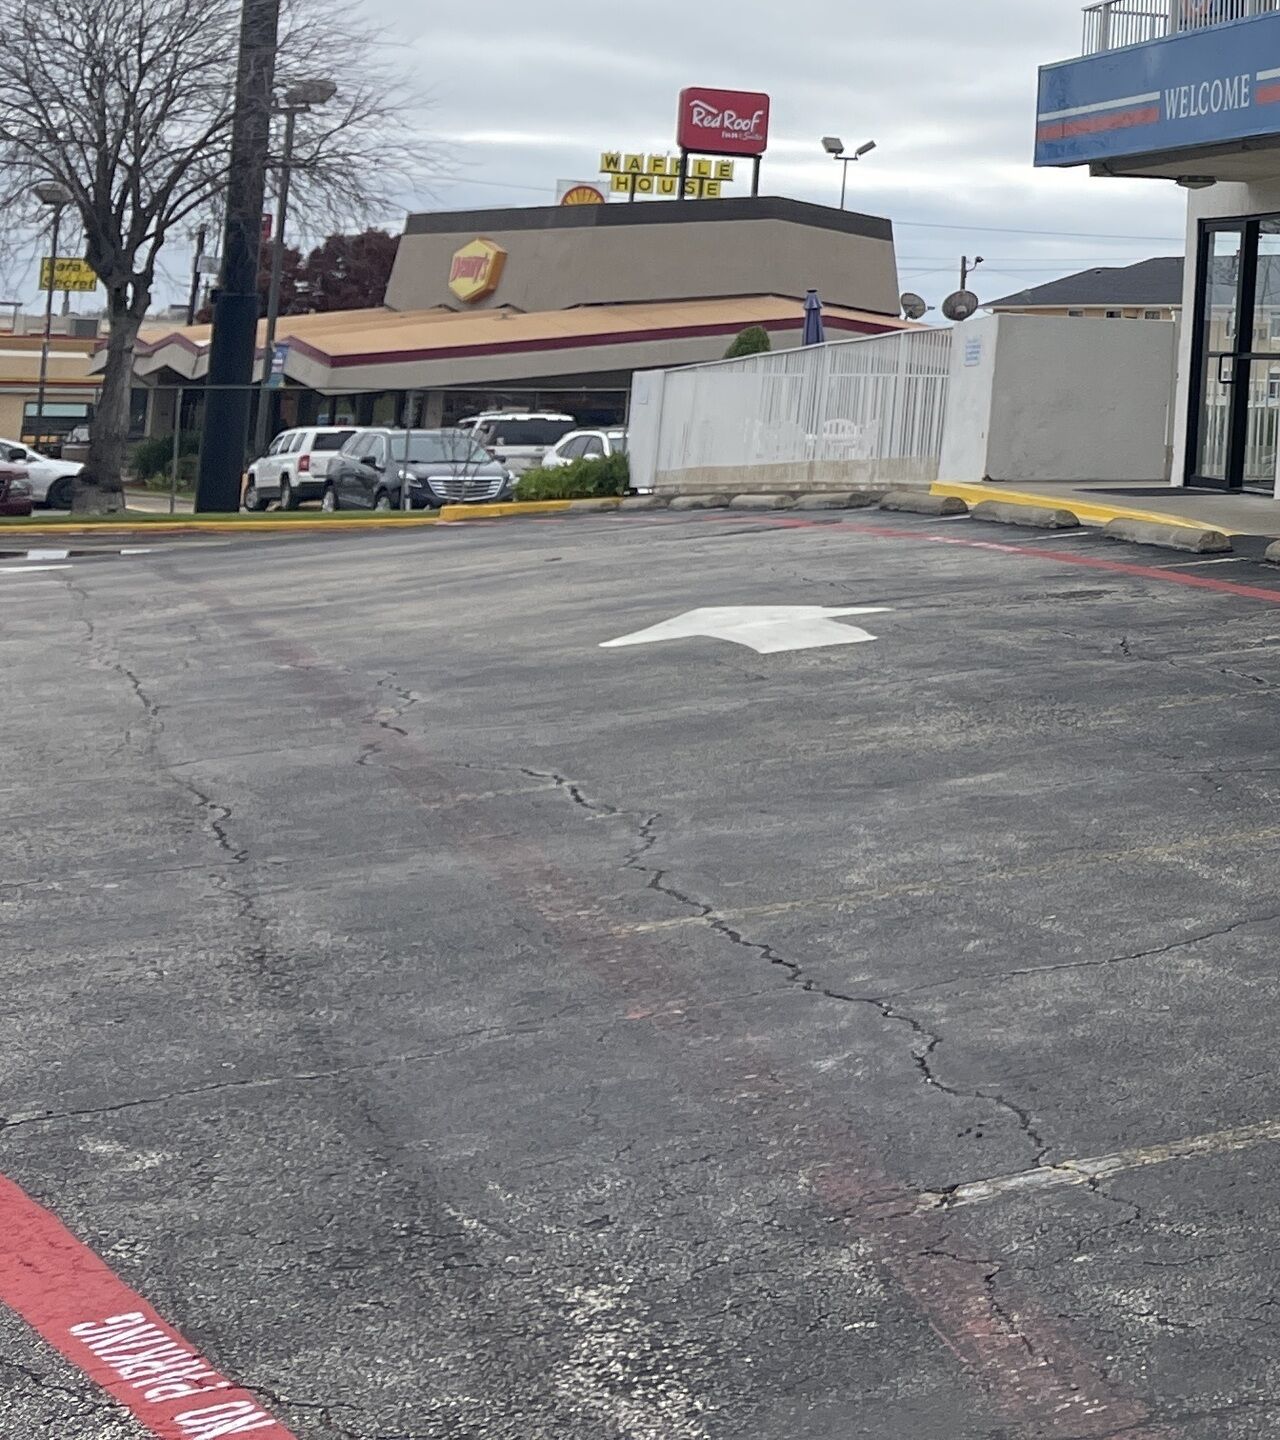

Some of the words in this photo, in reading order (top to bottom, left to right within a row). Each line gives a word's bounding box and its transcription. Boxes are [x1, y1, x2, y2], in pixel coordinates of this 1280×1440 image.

[1164, 73, 1250, 121] WELCOME
[692, 107, 722, 128] Red
[723, 110, 763, 133] Roof
[616, 179, 718, 196] HOUSE
[69, 1311, 232, 1403] PARKING
